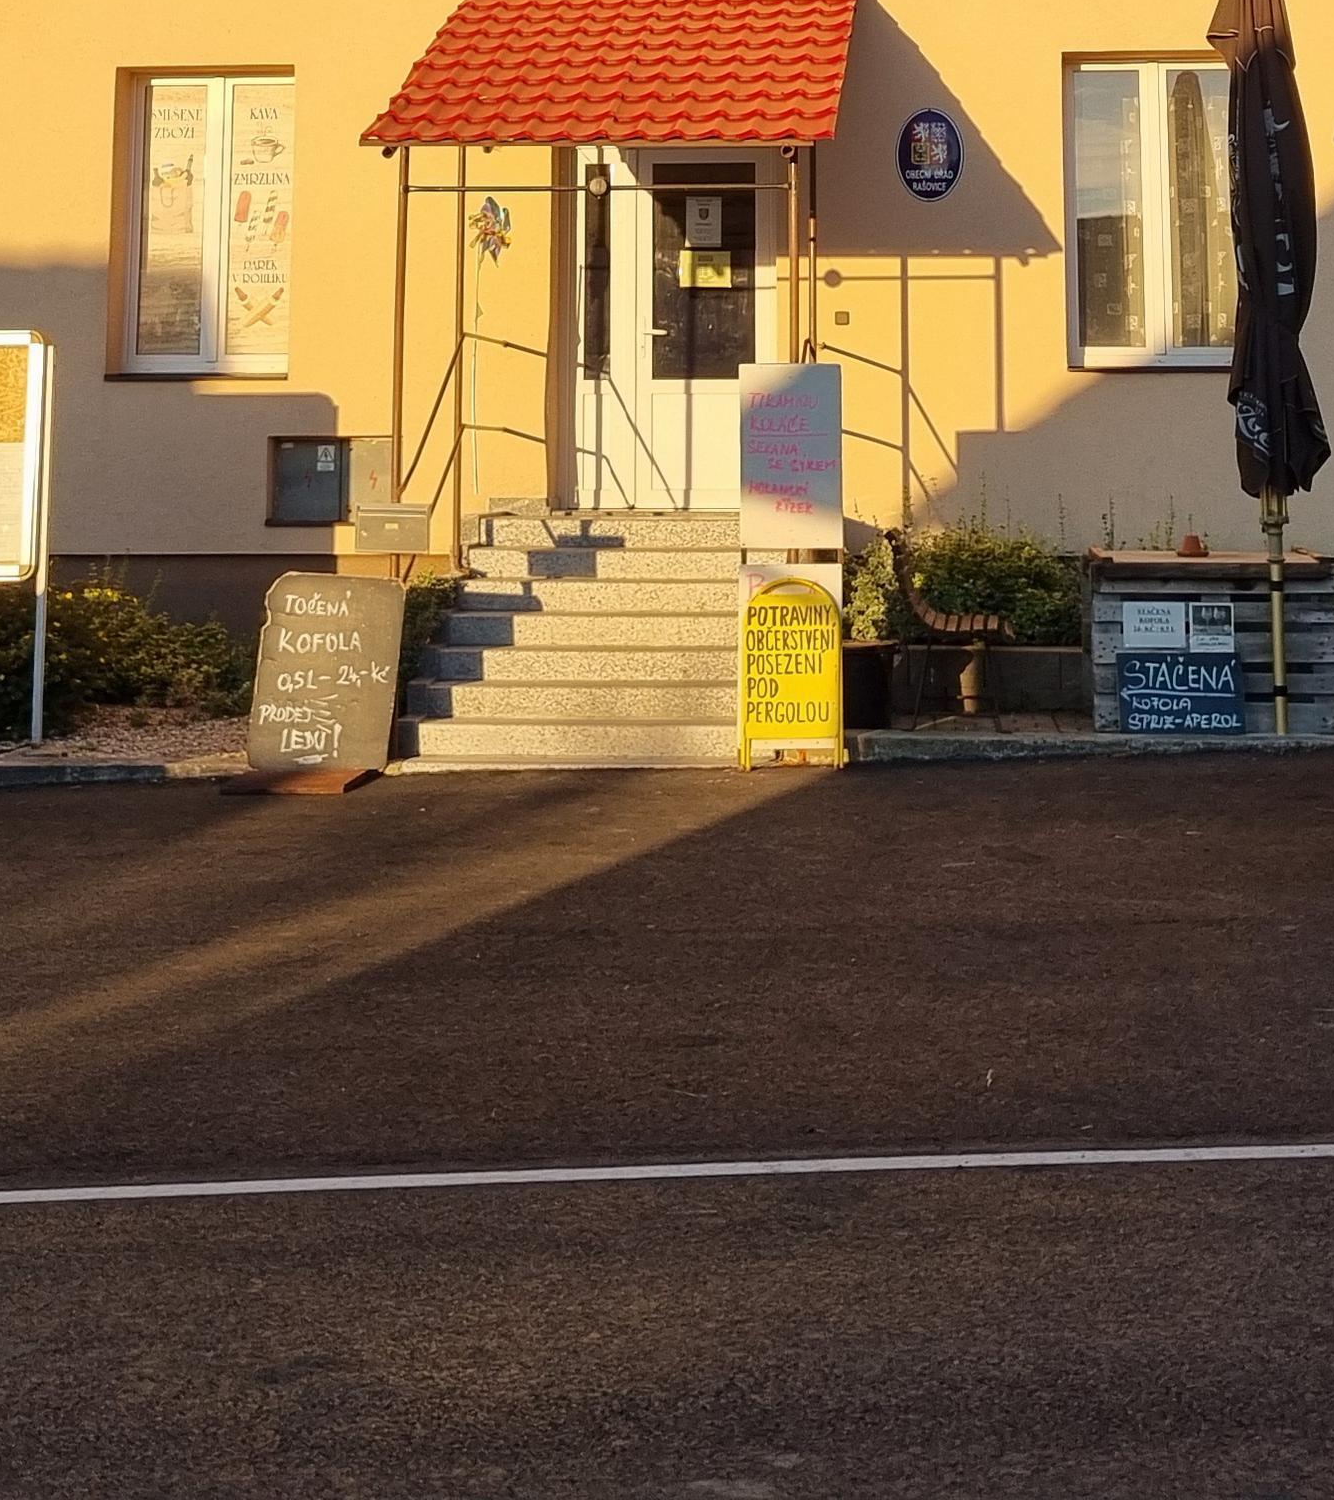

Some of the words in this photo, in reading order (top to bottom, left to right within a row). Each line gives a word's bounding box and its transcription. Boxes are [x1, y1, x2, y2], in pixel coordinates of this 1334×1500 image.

[234, 173, 290, 186] ZMRZLINA
[285, 590, 352, 617] TOČENÁ
[278, 627, 362, 654] KOFOLA
[746, 648, 826, 675] POSEZENÍ
[1123, 655, 1236, 691] STÁČENÁ
[747, 676, 779, 699] POD
[746, 701, 830, 724] PERGOLOU
[1132, 696, 1192, 711] KOFOLA
